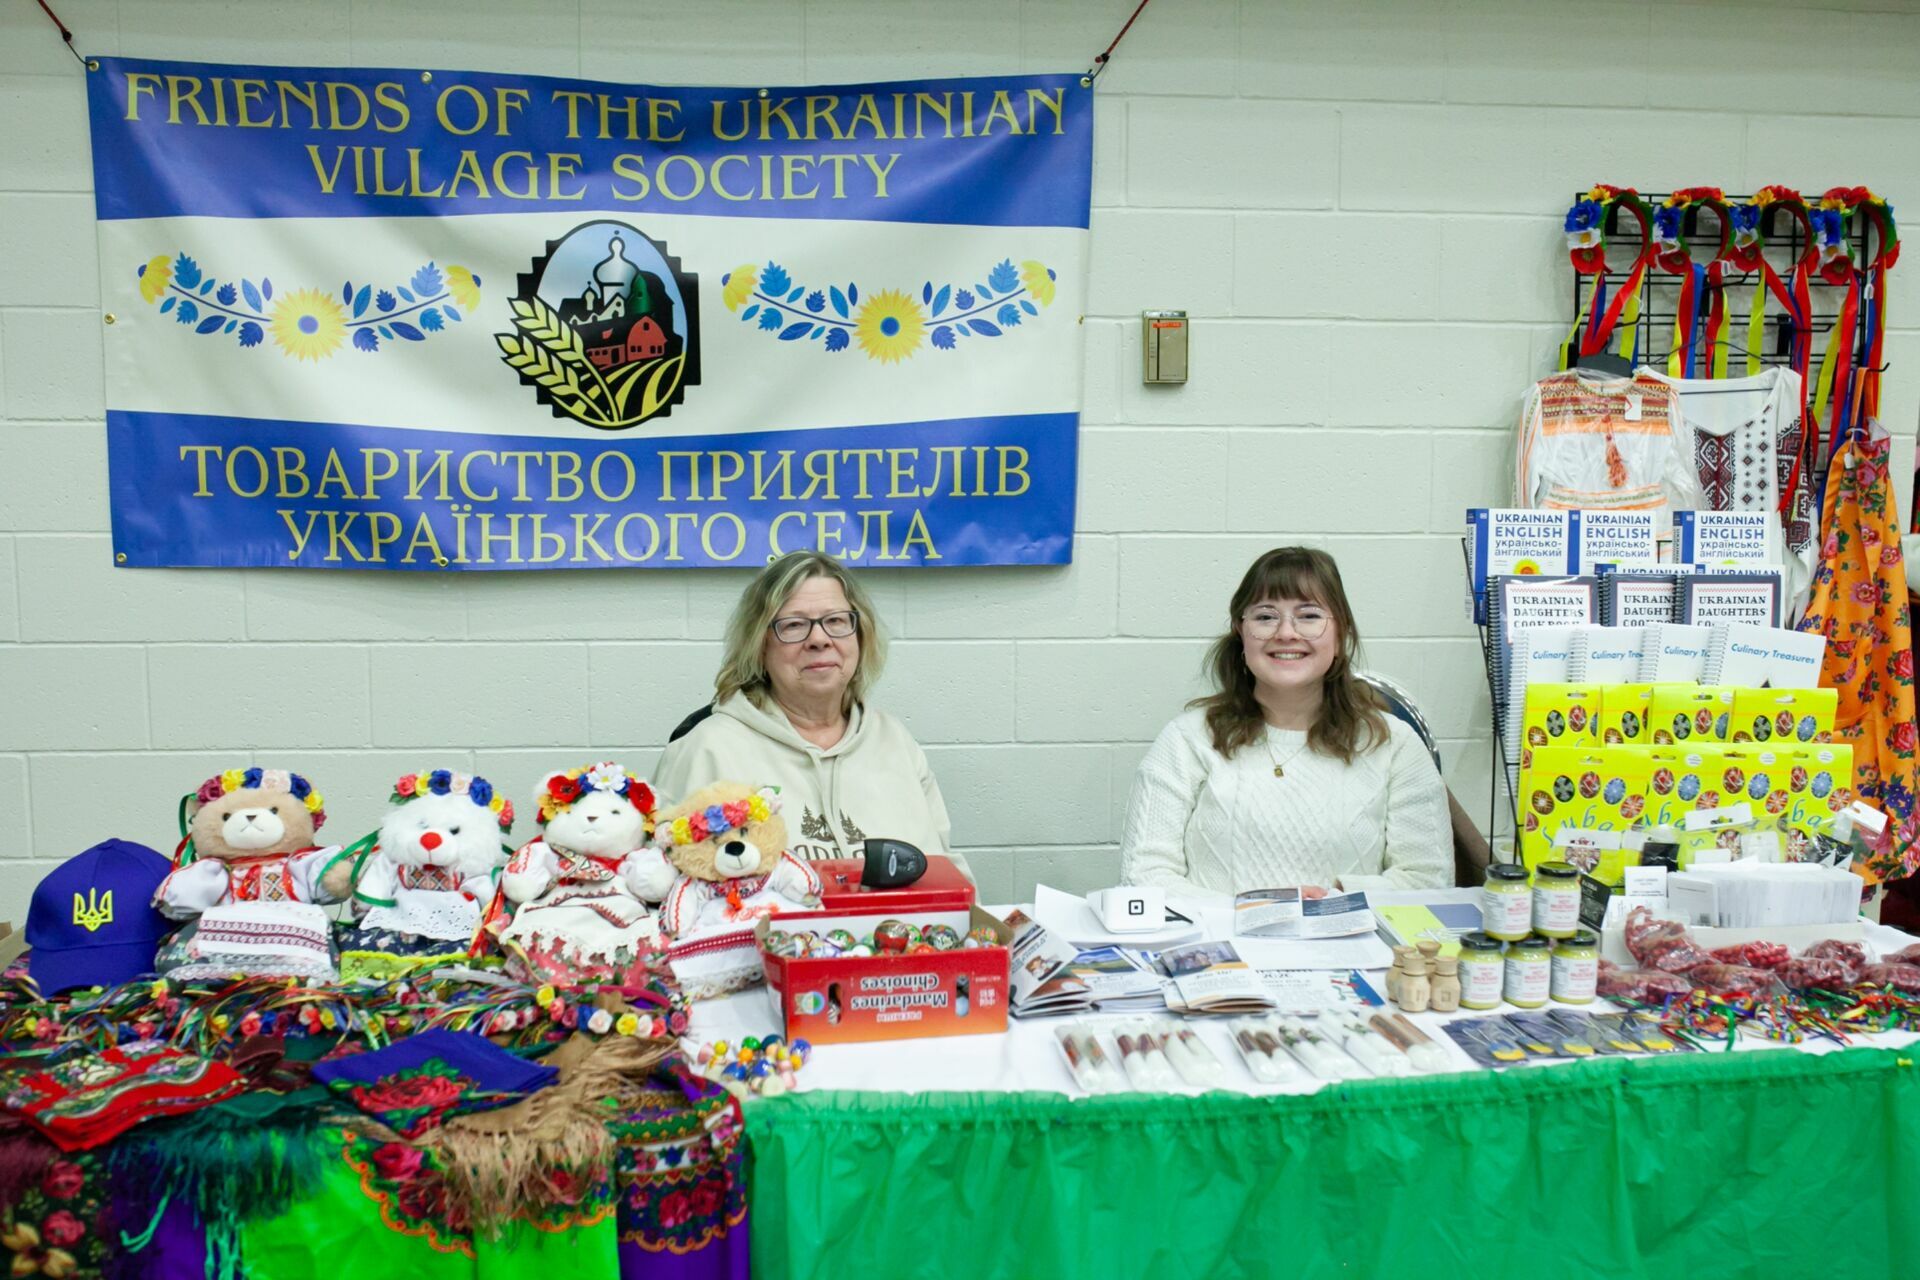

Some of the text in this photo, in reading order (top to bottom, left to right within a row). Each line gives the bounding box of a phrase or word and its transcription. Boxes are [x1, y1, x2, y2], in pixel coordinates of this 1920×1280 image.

[123, 72, 1066, 142] FRIENDS OF THE UKRAINIAN
[304, 144, 903, 202] VILLAGE SOCIETY
[178, 444, 1032, 503] ТОВАРИСТВО ПРИЯТЕЛІВ
[1495, 513, 1563, 524] UKRAINIAN
[1586, 514, 1651, 525] UKRAINIAN
[1700, 515, 1765, 525] UKRAINIAN
[276, 503, 943, 564] УКРАЇНЬКОГО СЕЛА
[1495, 526, 1563, 539] ENGLISH
[1586, 528, 1651, 539] ENGLISH
[1700, 528, 1765, 540] ENGLISH
[1495, 538, 1563, 549] українсько-
[1586, 539, 1651, 550] українсько-
[1700, 540, 1765, 551] українсько-
[1494, 549, 1562, 559] англійський
[1586, 549, 1651, 559] англійський
[1700, 550, 1764, 560] англійський
[1513, 596, 1584, 605] UKRAINIAN
[1699, 596, 1766, 604] UKRAINIAN
[1532, 650, 1567, 661] Culinary
[1591, 650, 1625, 661] Culinary
[1664, 645, 1697, 659] Culinary
[1731, 643, 1815, 664] Culinary Treasures
[860, 973, 939, 992] Chinoises
[850, 990, 948, 1013] Mandarines
